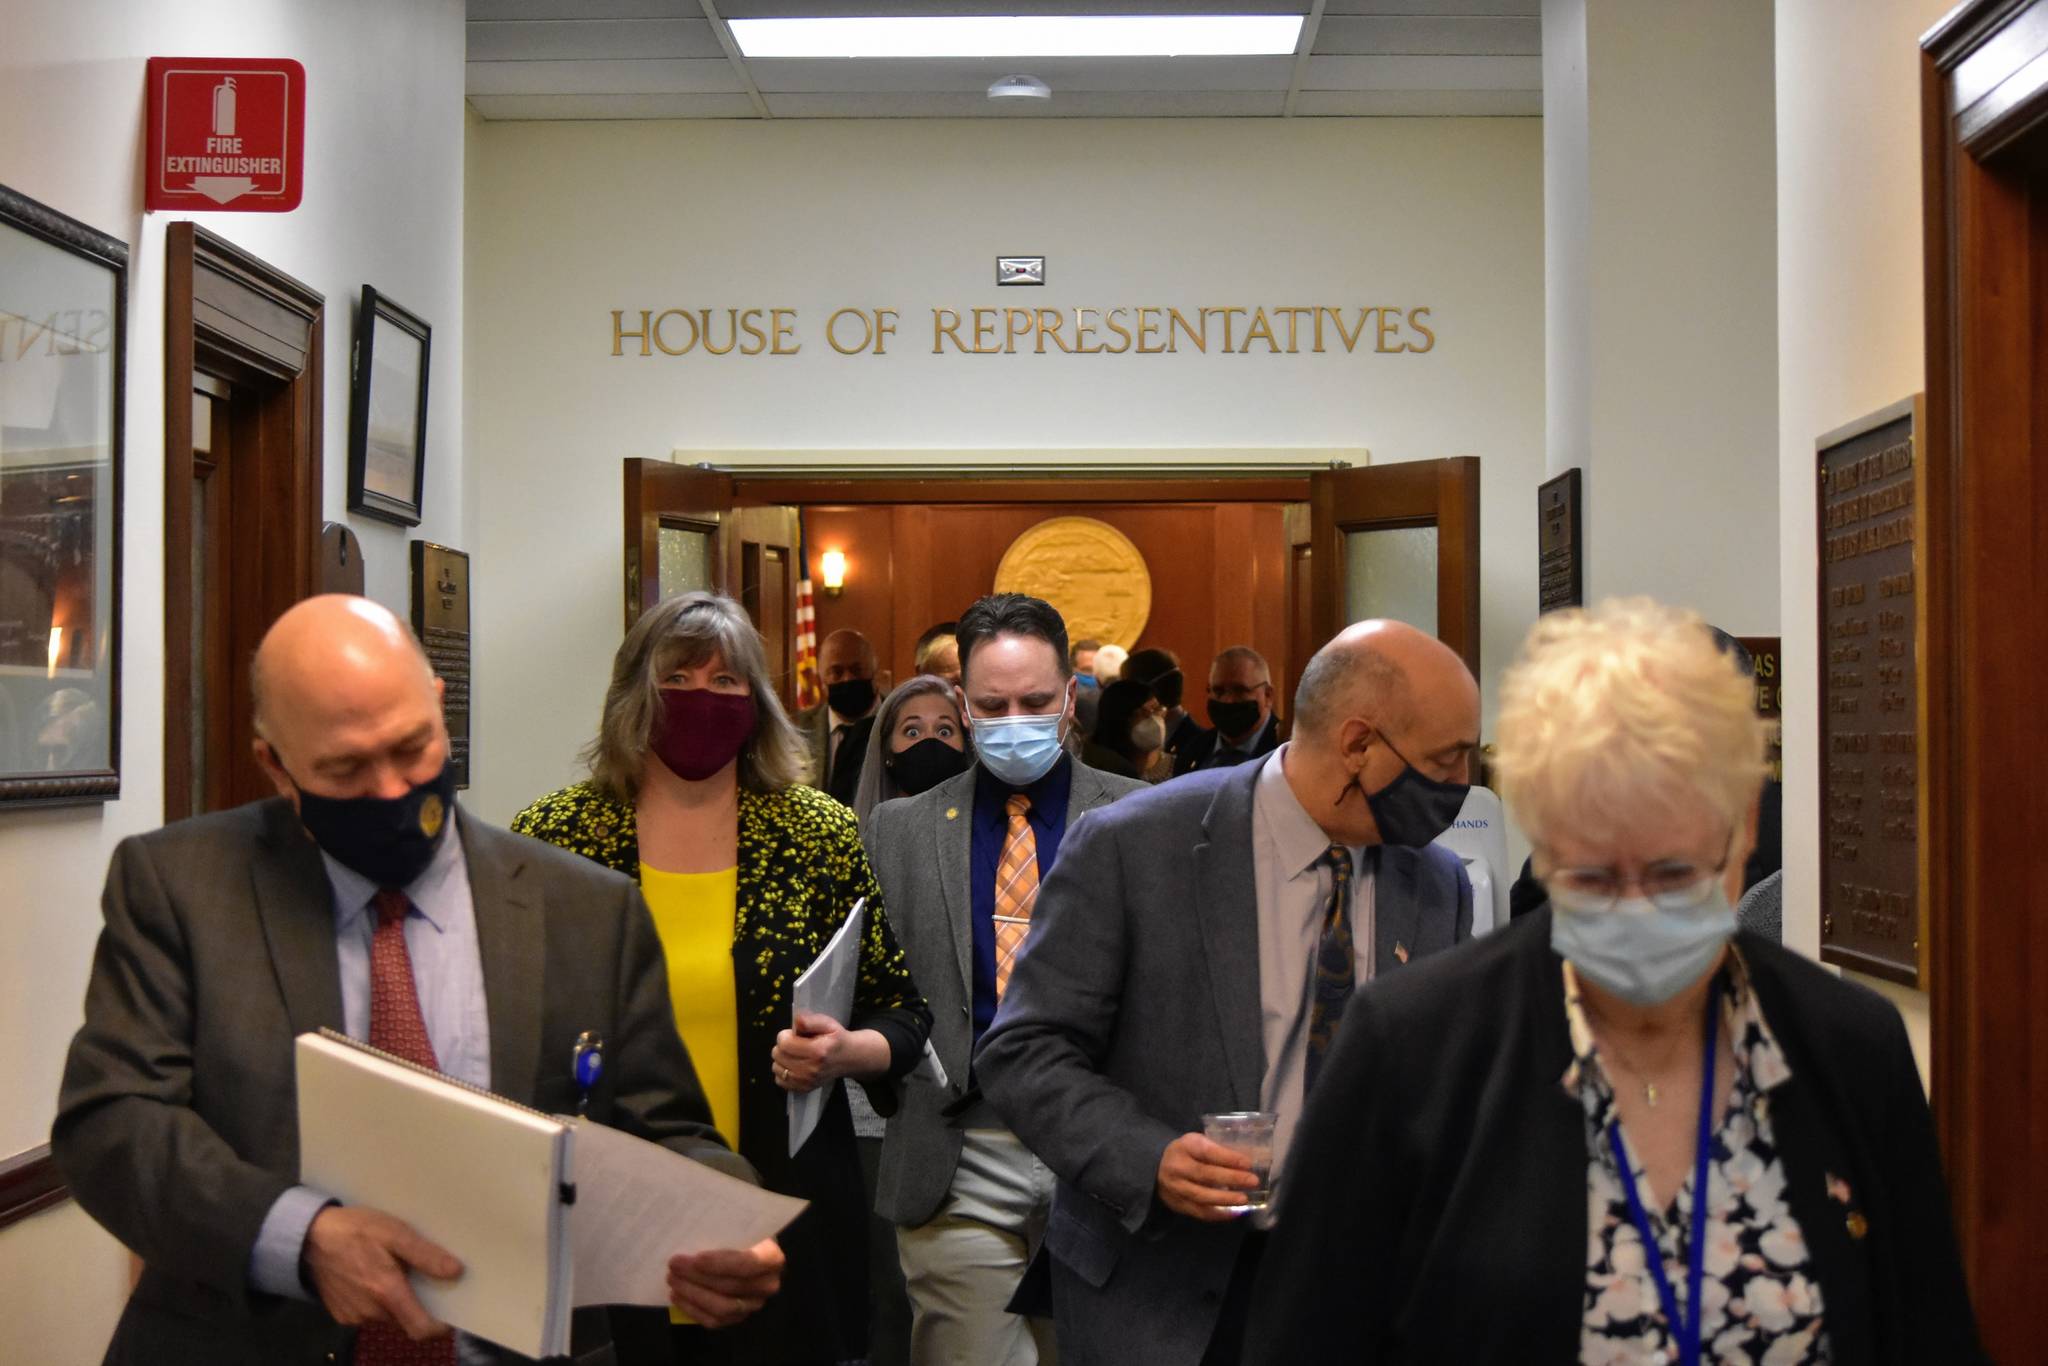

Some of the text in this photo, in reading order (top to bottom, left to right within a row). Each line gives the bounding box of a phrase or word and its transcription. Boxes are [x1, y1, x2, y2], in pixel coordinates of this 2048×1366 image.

[207, 137, 243, 154] FIRE
[166, 156, 282, 174] EXTINGUISHER
[611, 306, 1436, 356] HOUSE OF REPRESENTATIVES
[1453, 819, 1488, 828] HANDS
